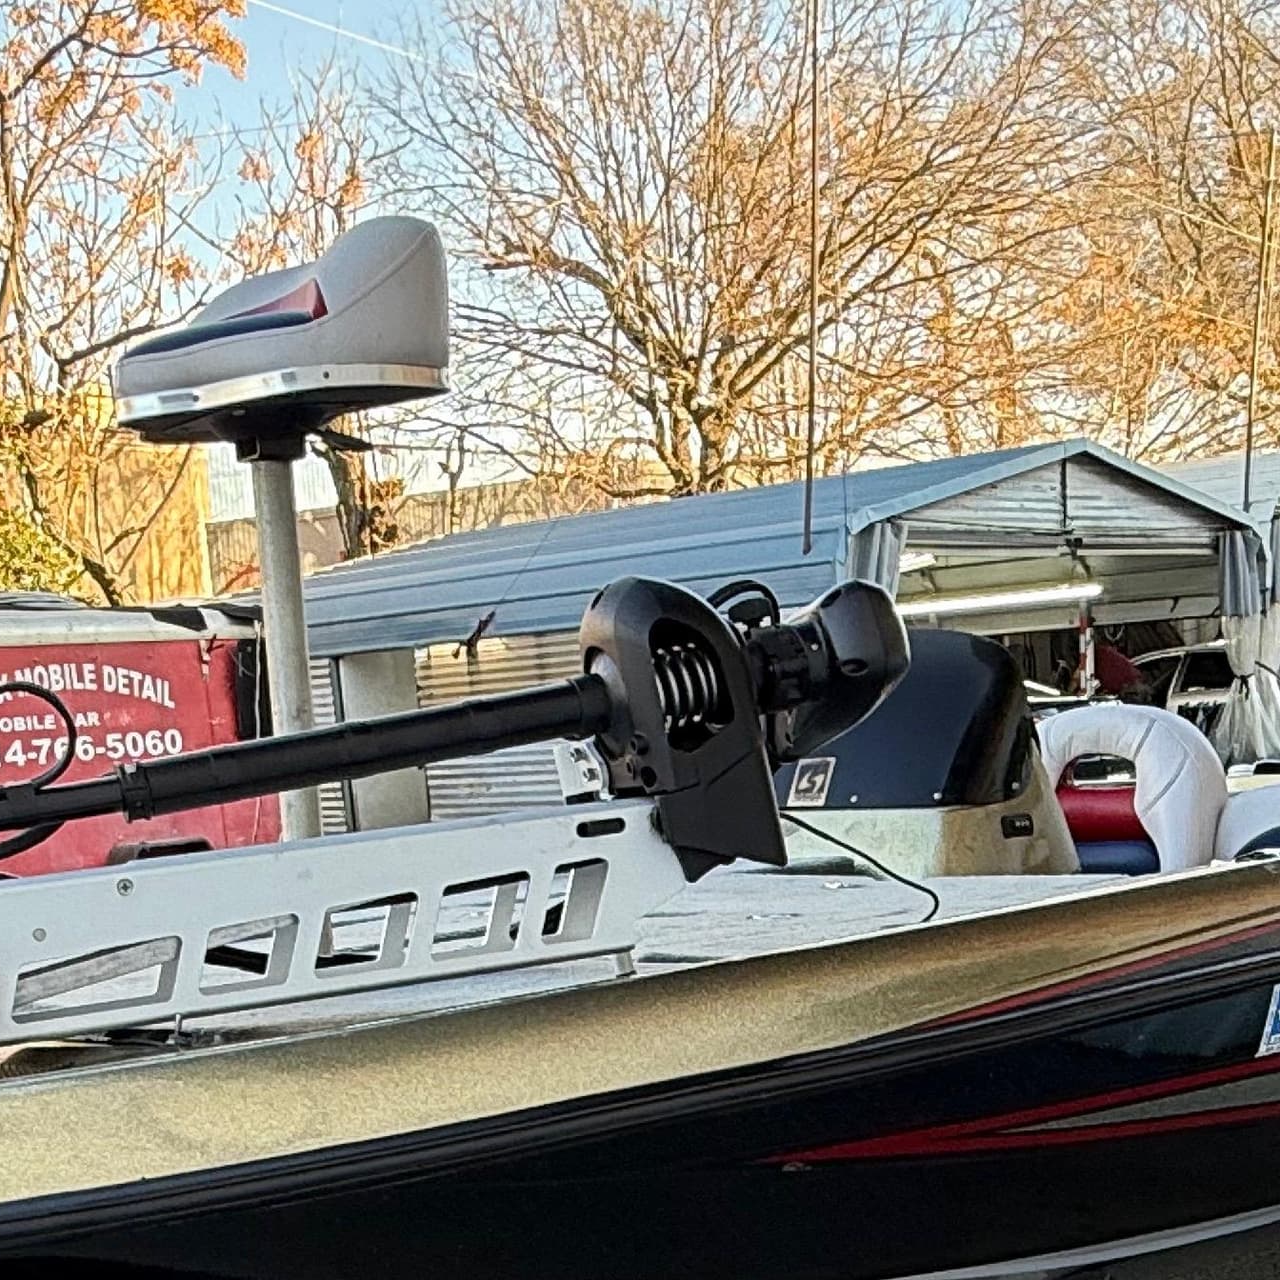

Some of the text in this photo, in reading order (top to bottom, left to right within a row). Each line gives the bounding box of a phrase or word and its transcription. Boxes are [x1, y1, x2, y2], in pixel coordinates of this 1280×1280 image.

[14, 663, 97, 699] MOBILE
[102, 665, 176, 709] DETAIL
[61, 711, 101, 729] AR
